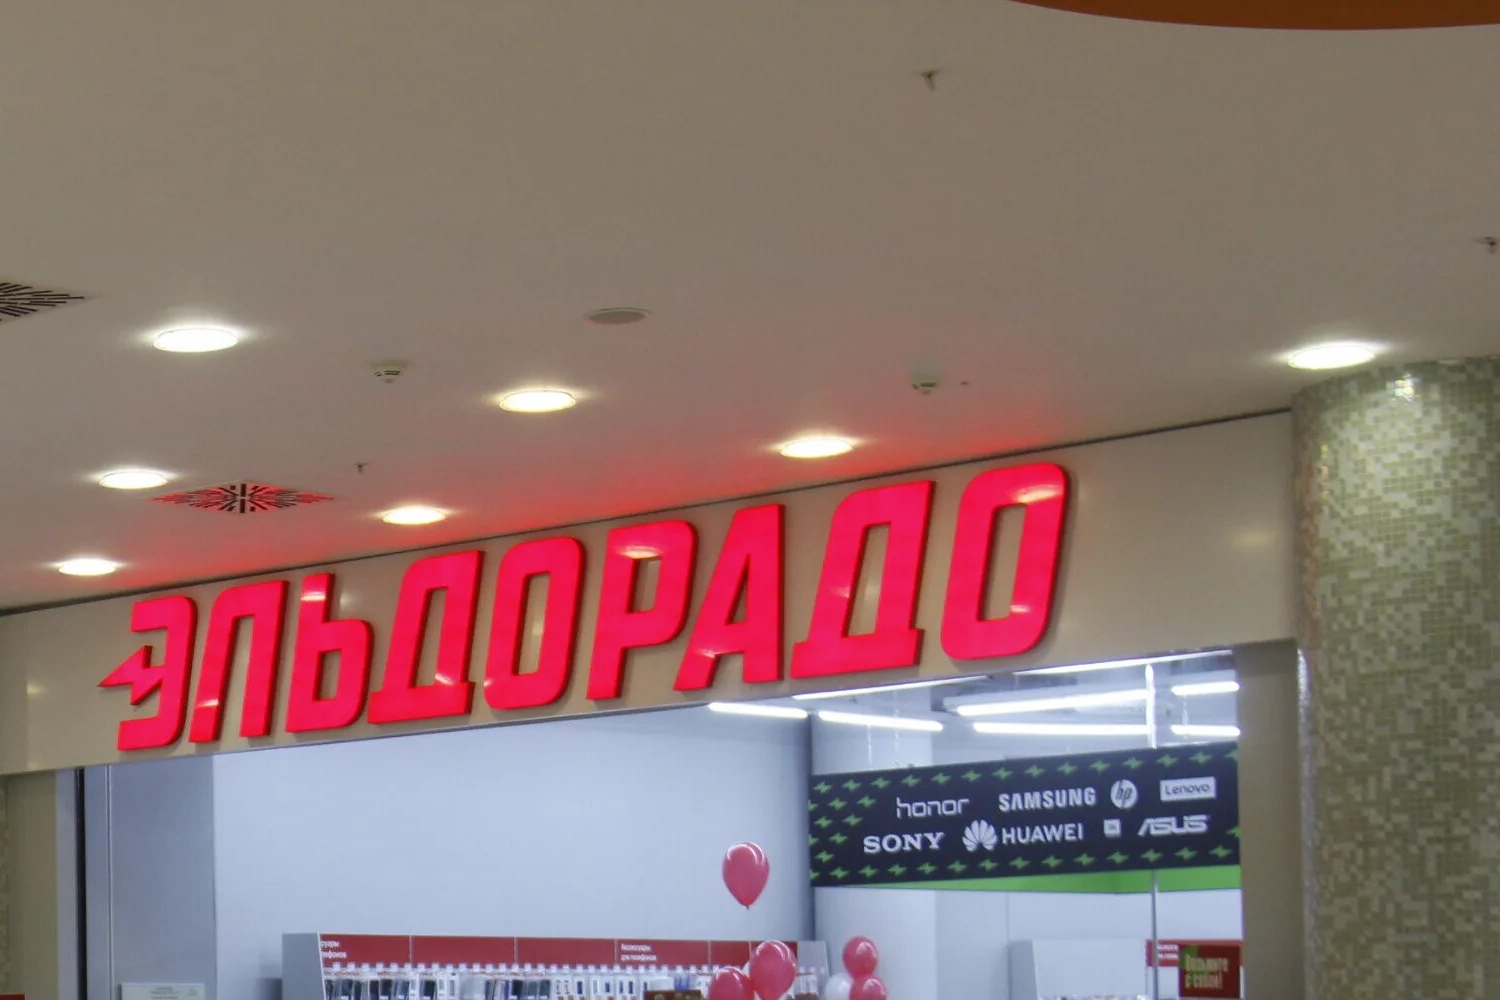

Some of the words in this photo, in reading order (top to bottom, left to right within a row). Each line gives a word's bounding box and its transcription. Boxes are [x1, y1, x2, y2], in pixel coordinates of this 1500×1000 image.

[99, 461, 1069, 752] ЭЛЬДОРАДО
[895, 795, 970, 819] honor
[998, 786, 1098, 813] SAMSUNG
[1165, 782, 1211, 797] Lenovo
[862, 832, 946, 854] SONY
[1001, 823, 1085, 845] HUAWEI
[1137, 814, 1210, 837] ASUS
